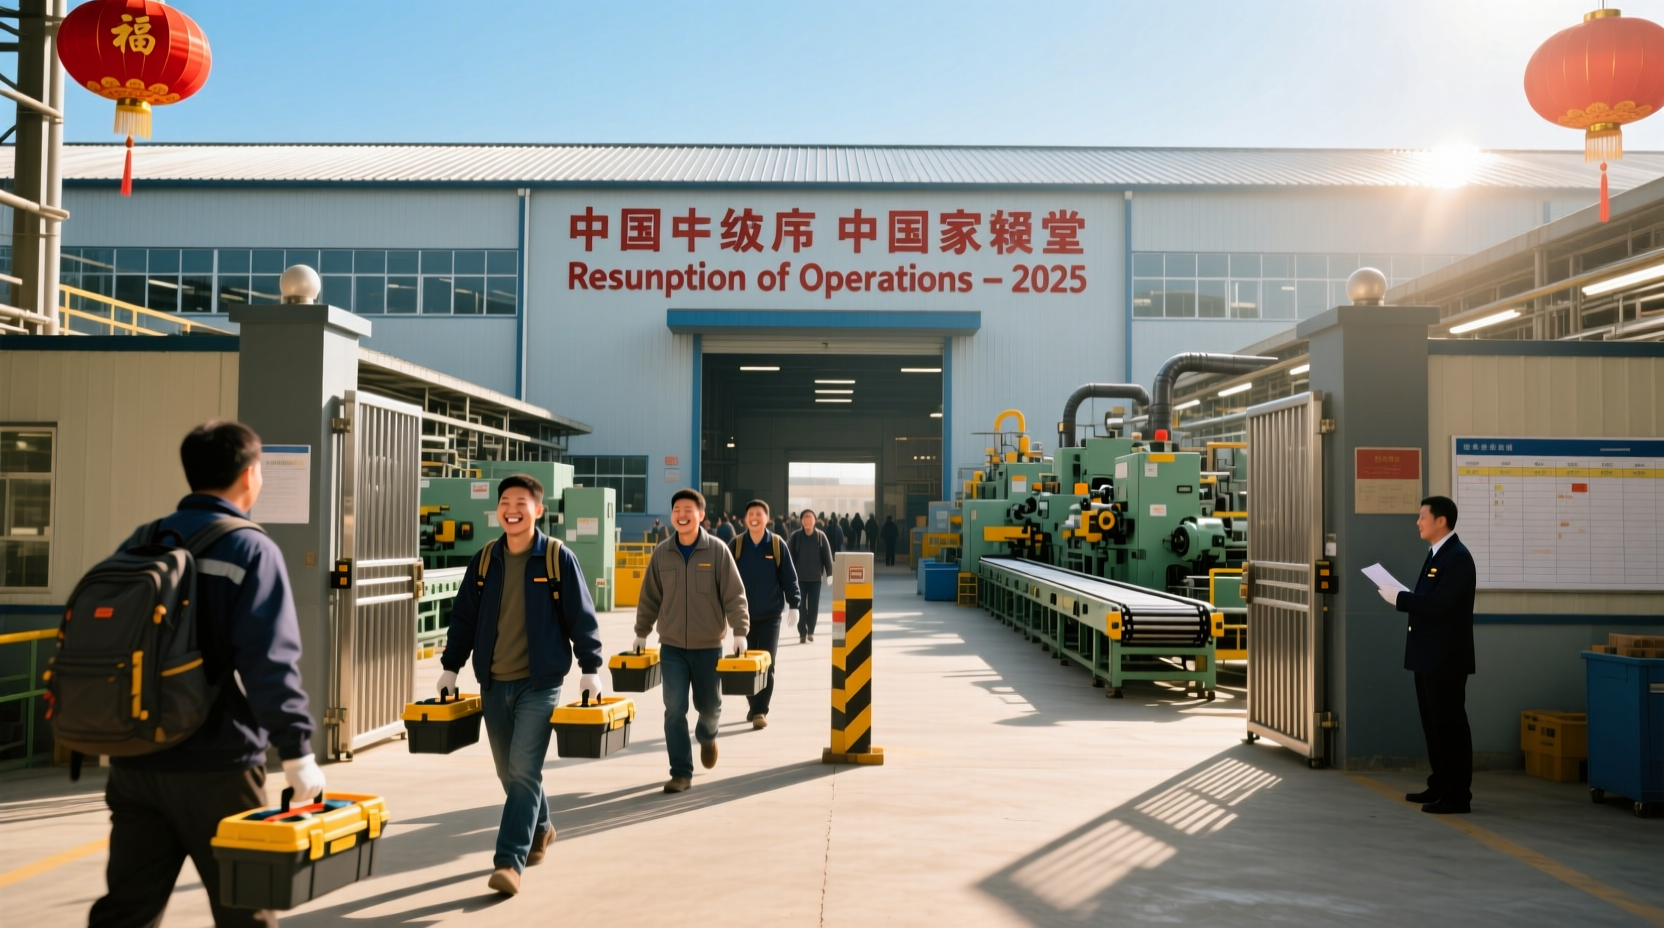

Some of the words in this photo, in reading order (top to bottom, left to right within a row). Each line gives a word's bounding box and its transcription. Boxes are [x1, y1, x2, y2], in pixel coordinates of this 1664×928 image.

[110, 14, 156, 56] 福
[568, 262, 746, 298] Resunption
[757, 261, 790, 292] of
[799, 263, 973, 299] Operations
[1011, 264, 1087, 294] 2025
